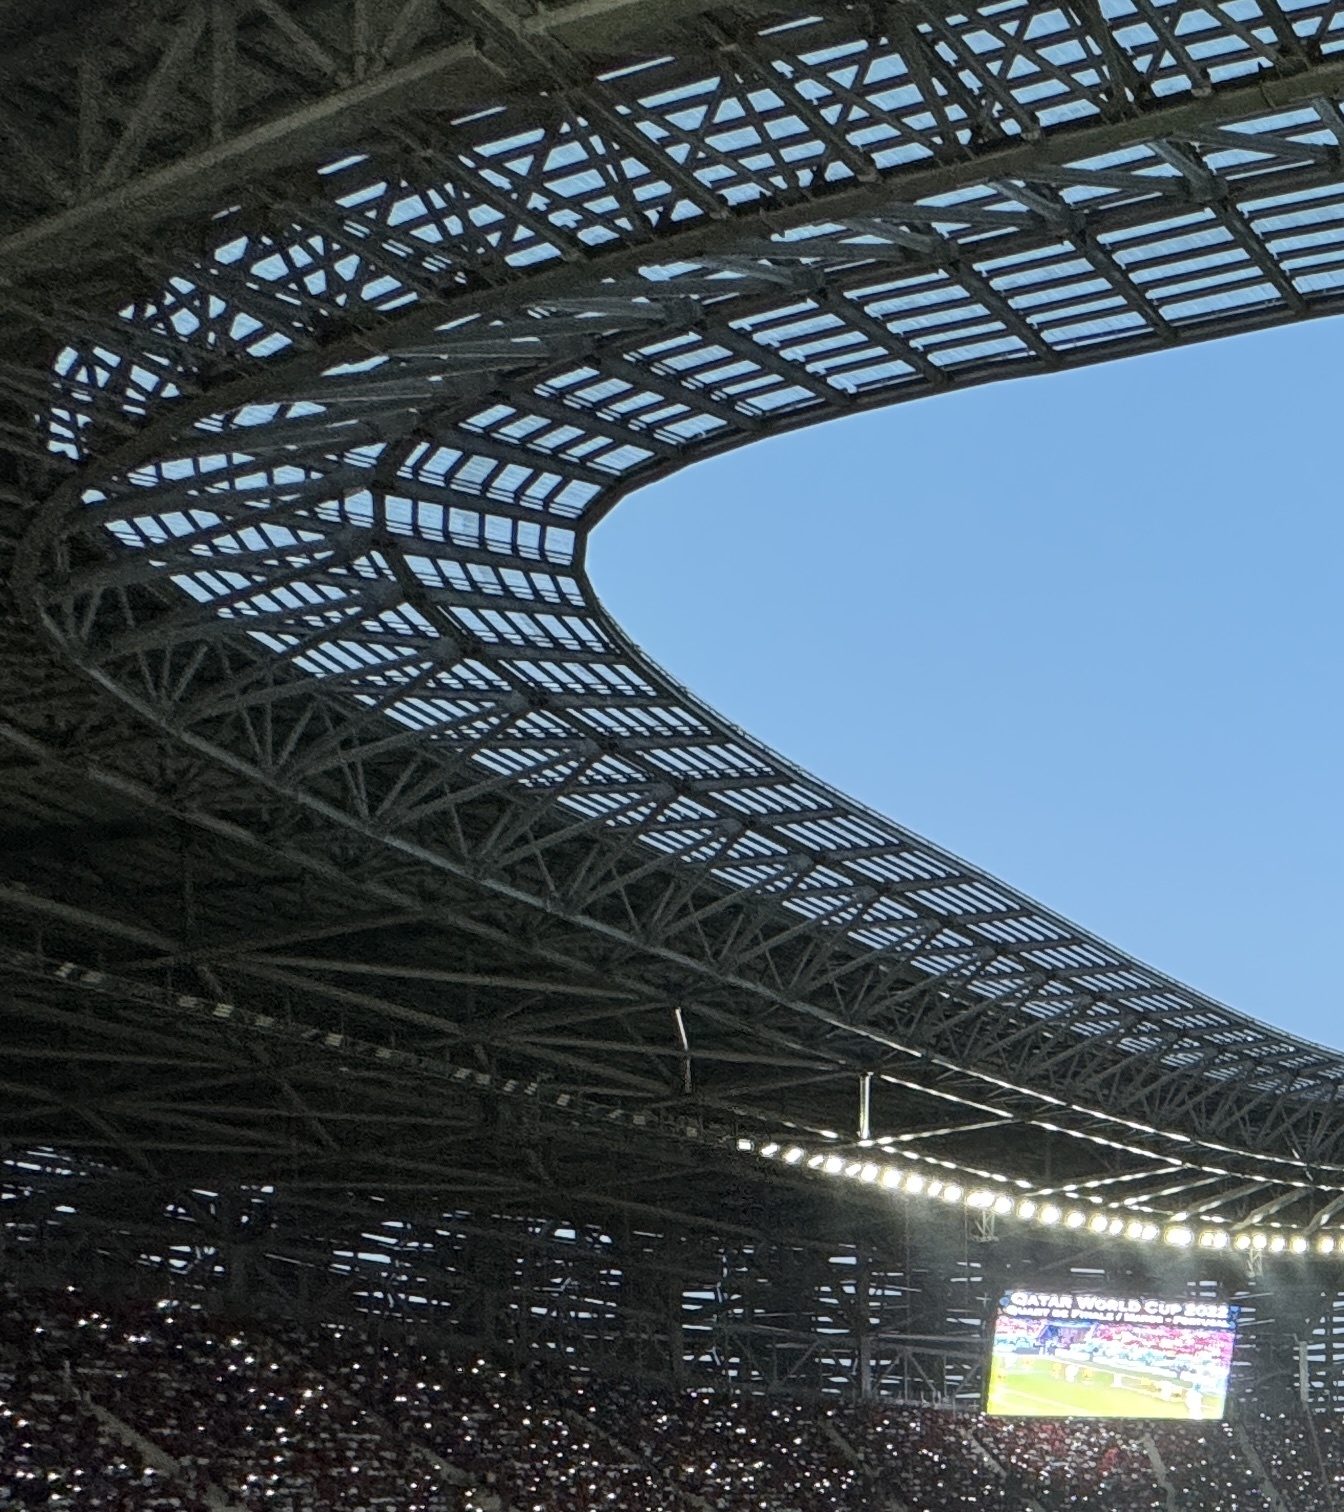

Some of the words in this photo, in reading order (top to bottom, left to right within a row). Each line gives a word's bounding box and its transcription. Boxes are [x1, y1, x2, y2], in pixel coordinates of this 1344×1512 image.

[1010, 1292, 1073, 1309] QATAR
[1076, 1296, 1141, 1313] WORLD
[1144, 1300, 1182, 1314] CUP
[1184, 1303, 1228, 1319] 2022
